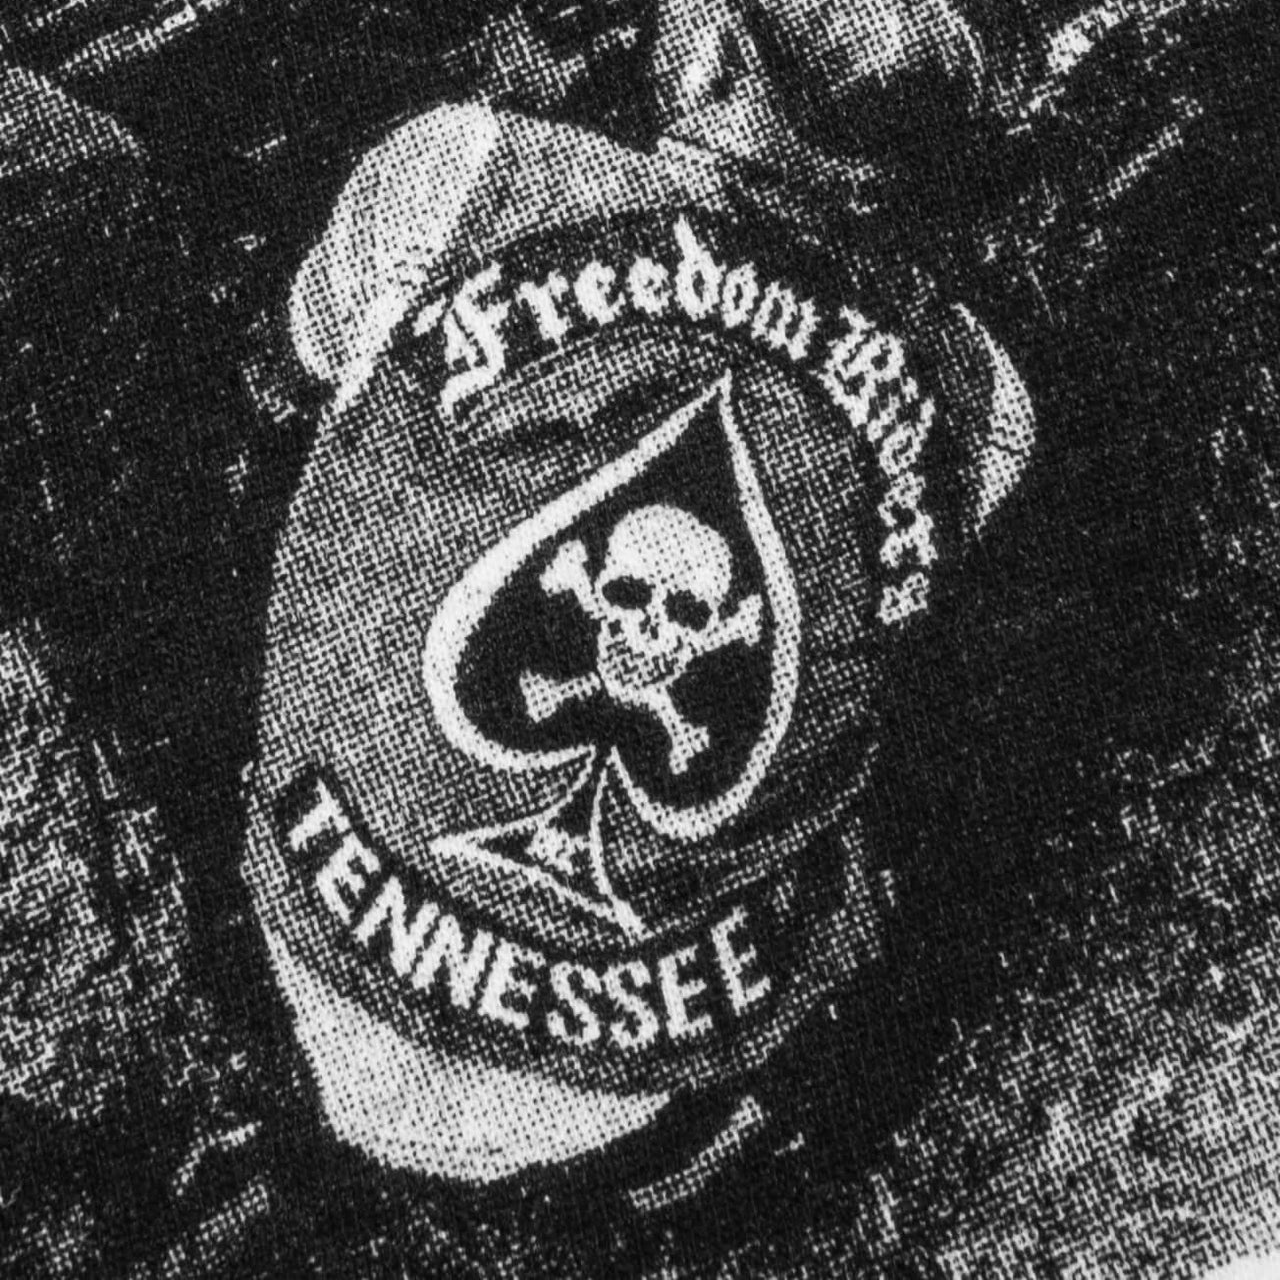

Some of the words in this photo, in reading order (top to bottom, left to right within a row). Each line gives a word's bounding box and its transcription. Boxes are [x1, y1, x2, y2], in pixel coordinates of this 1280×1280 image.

[413, 212, 822, 429] Freedom
[818, 304, 938, 624] Riders
[287, 778, 772, 1049] TENNESSEE
